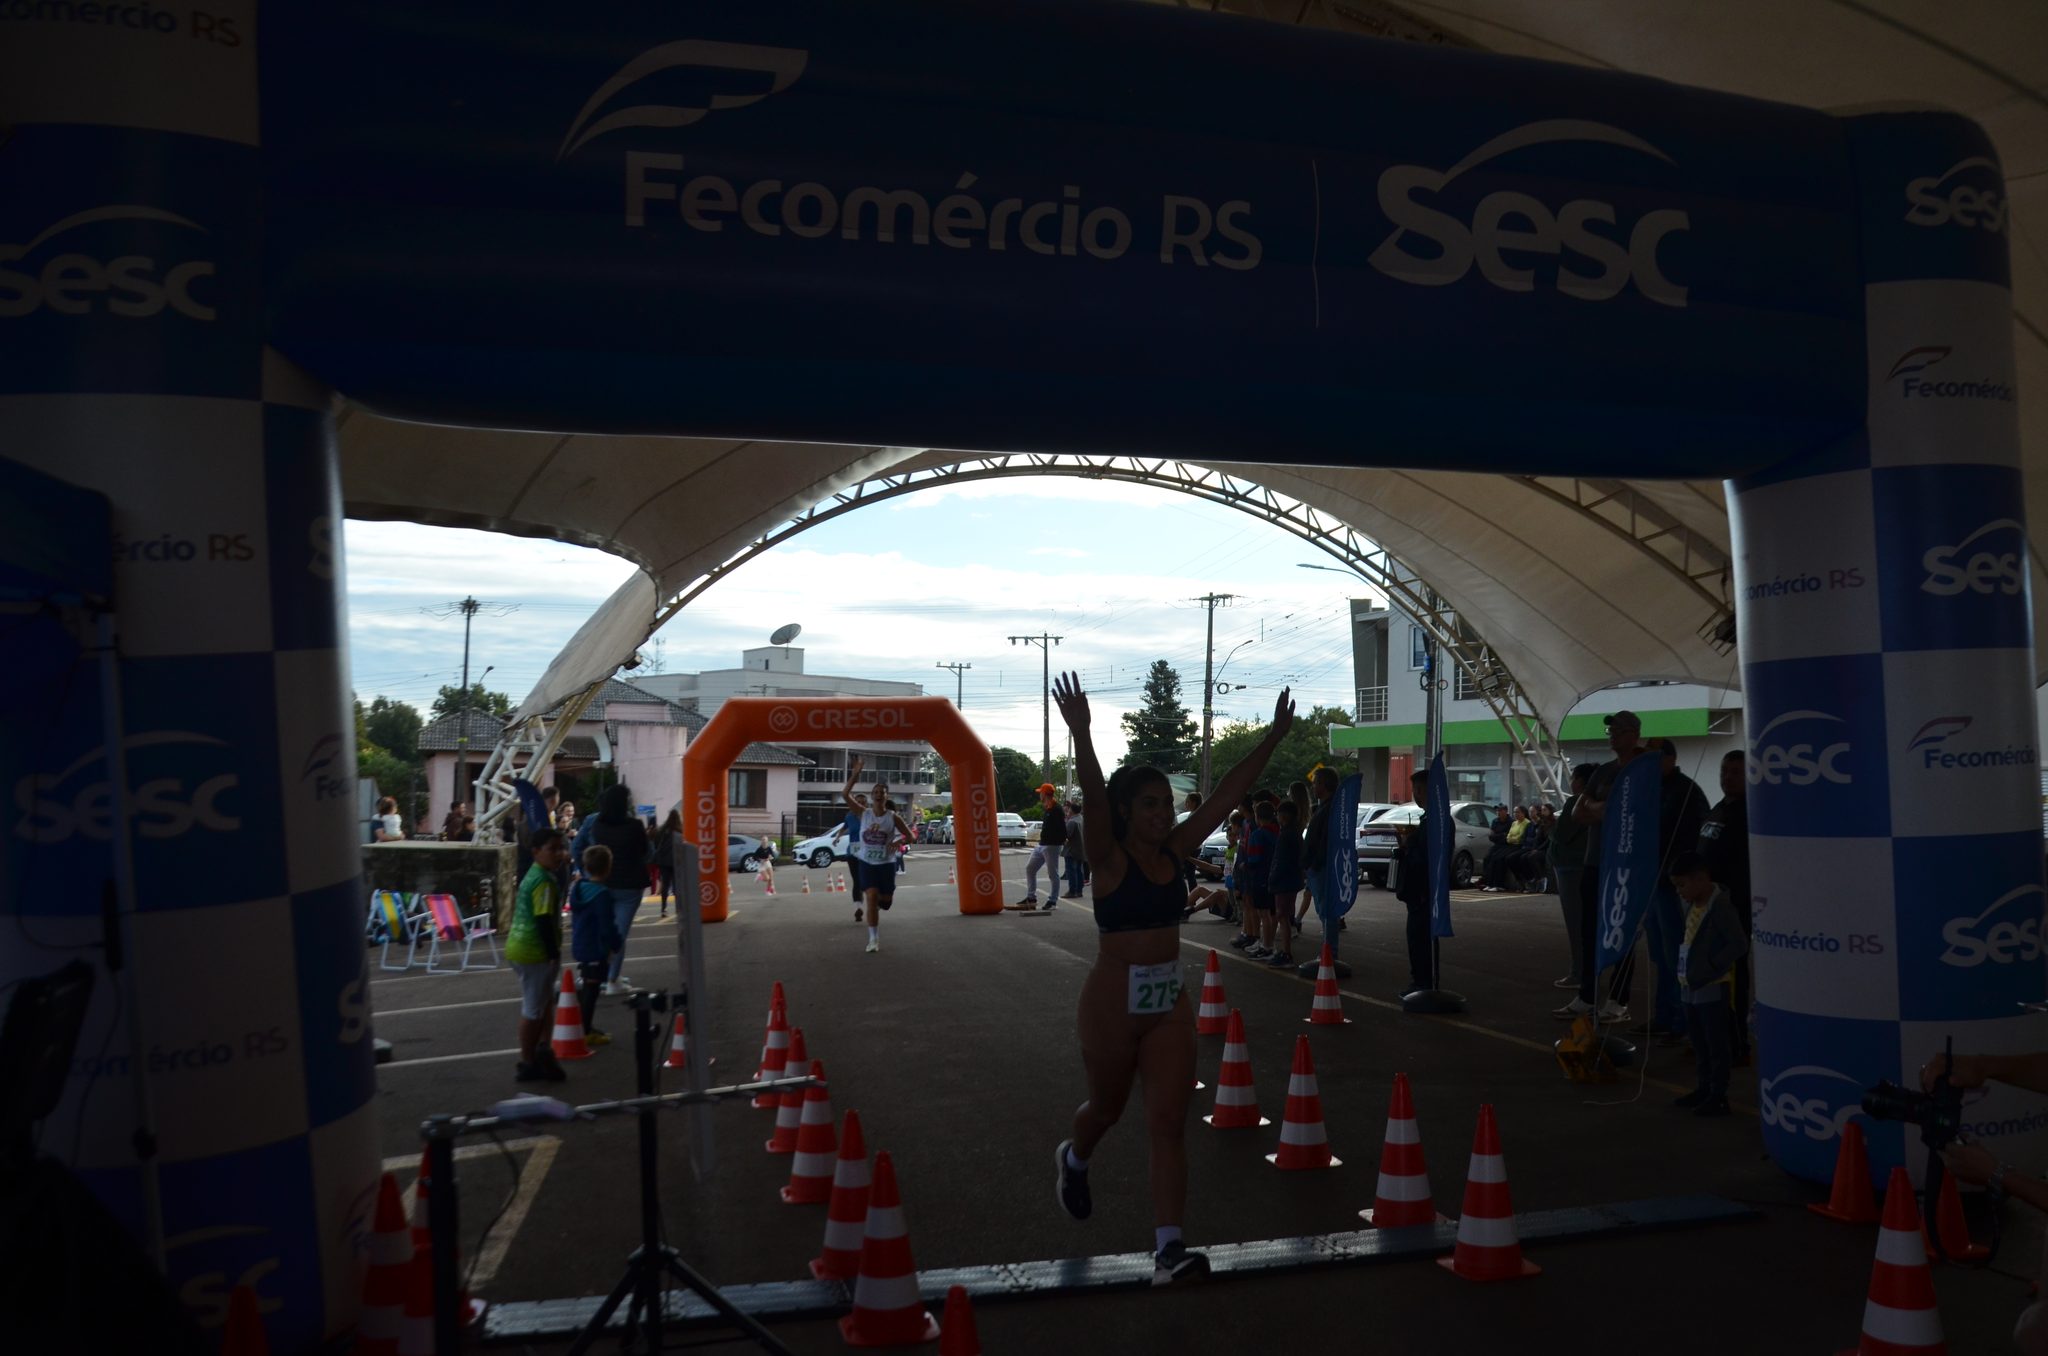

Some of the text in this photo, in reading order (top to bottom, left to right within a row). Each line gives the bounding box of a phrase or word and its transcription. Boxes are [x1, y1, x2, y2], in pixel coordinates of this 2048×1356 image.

[191, 10, 241, 47] RS
[624, 150, 1264, 271] Fecomércio RS
[1368, 118, 1692, 308] Sesc
[1904, 157, 2008, 232] Ses
[208, 533, 255, 562] RS
[1829, 567, 1866, 590] RS
[1920, 518, 2026, 596] Ses
[806, 707, 915, 730] CRESOL
[12, 730, 242, 844] Sesc
[970, 775, 993, 865] CRESOL
[697, 783, 717, 875] CRESOL
[1334, 847, 1353, 904] Sesc
[1602, 866, 1632, 952] Sesc
[1847, 934, 1884, 955] RS
[244, 1026, 288, 1058] RS
